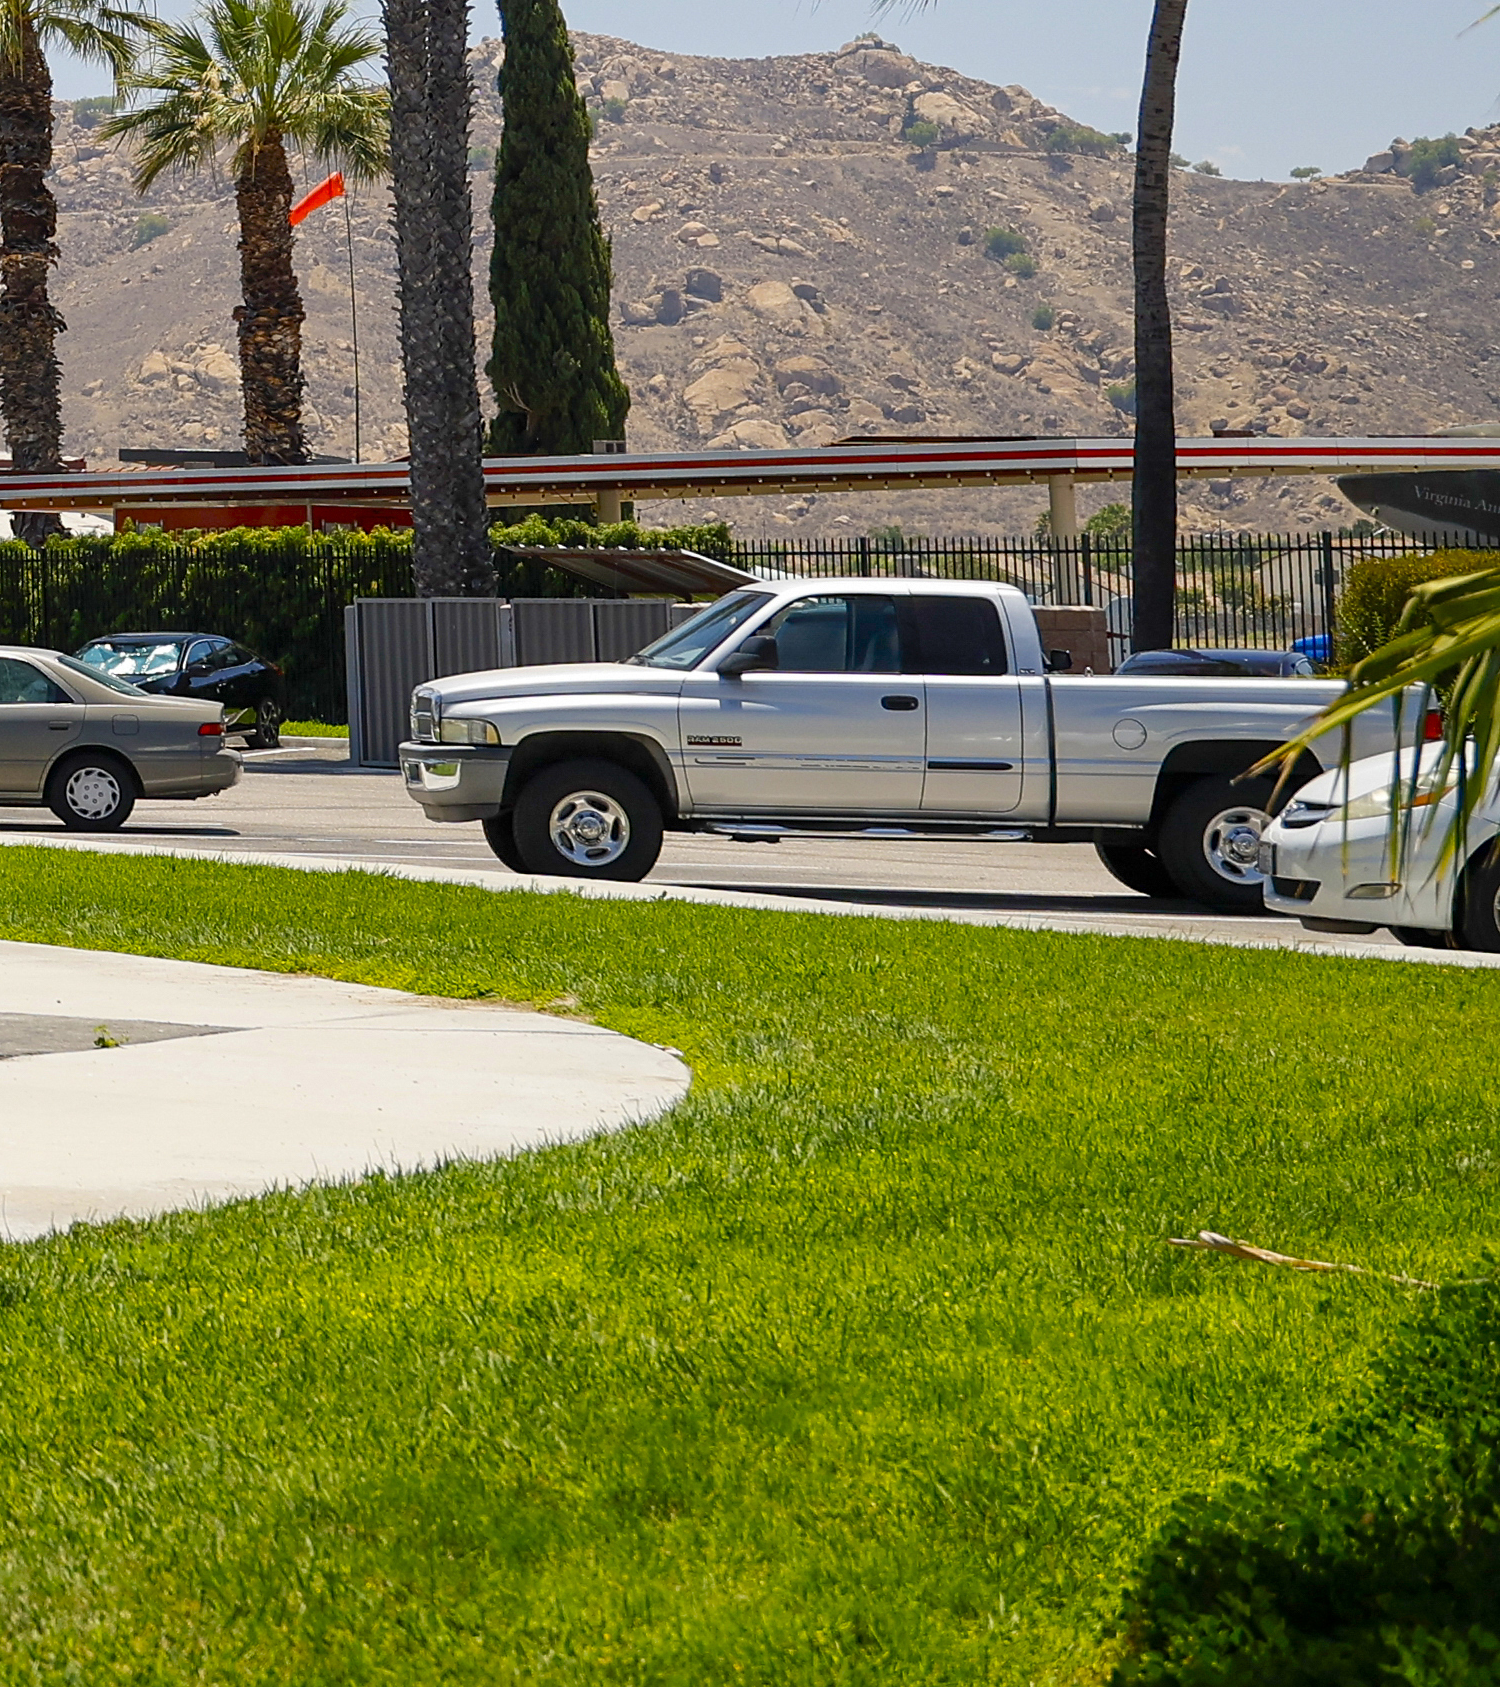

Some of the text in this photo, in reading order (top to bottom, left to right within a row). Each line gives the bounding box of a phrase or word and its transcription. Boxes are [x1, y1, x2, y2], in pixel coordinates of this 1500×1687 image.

[1414, 485, 1500, 514] Virginia An
[687, 735, 710, 743] RAM
